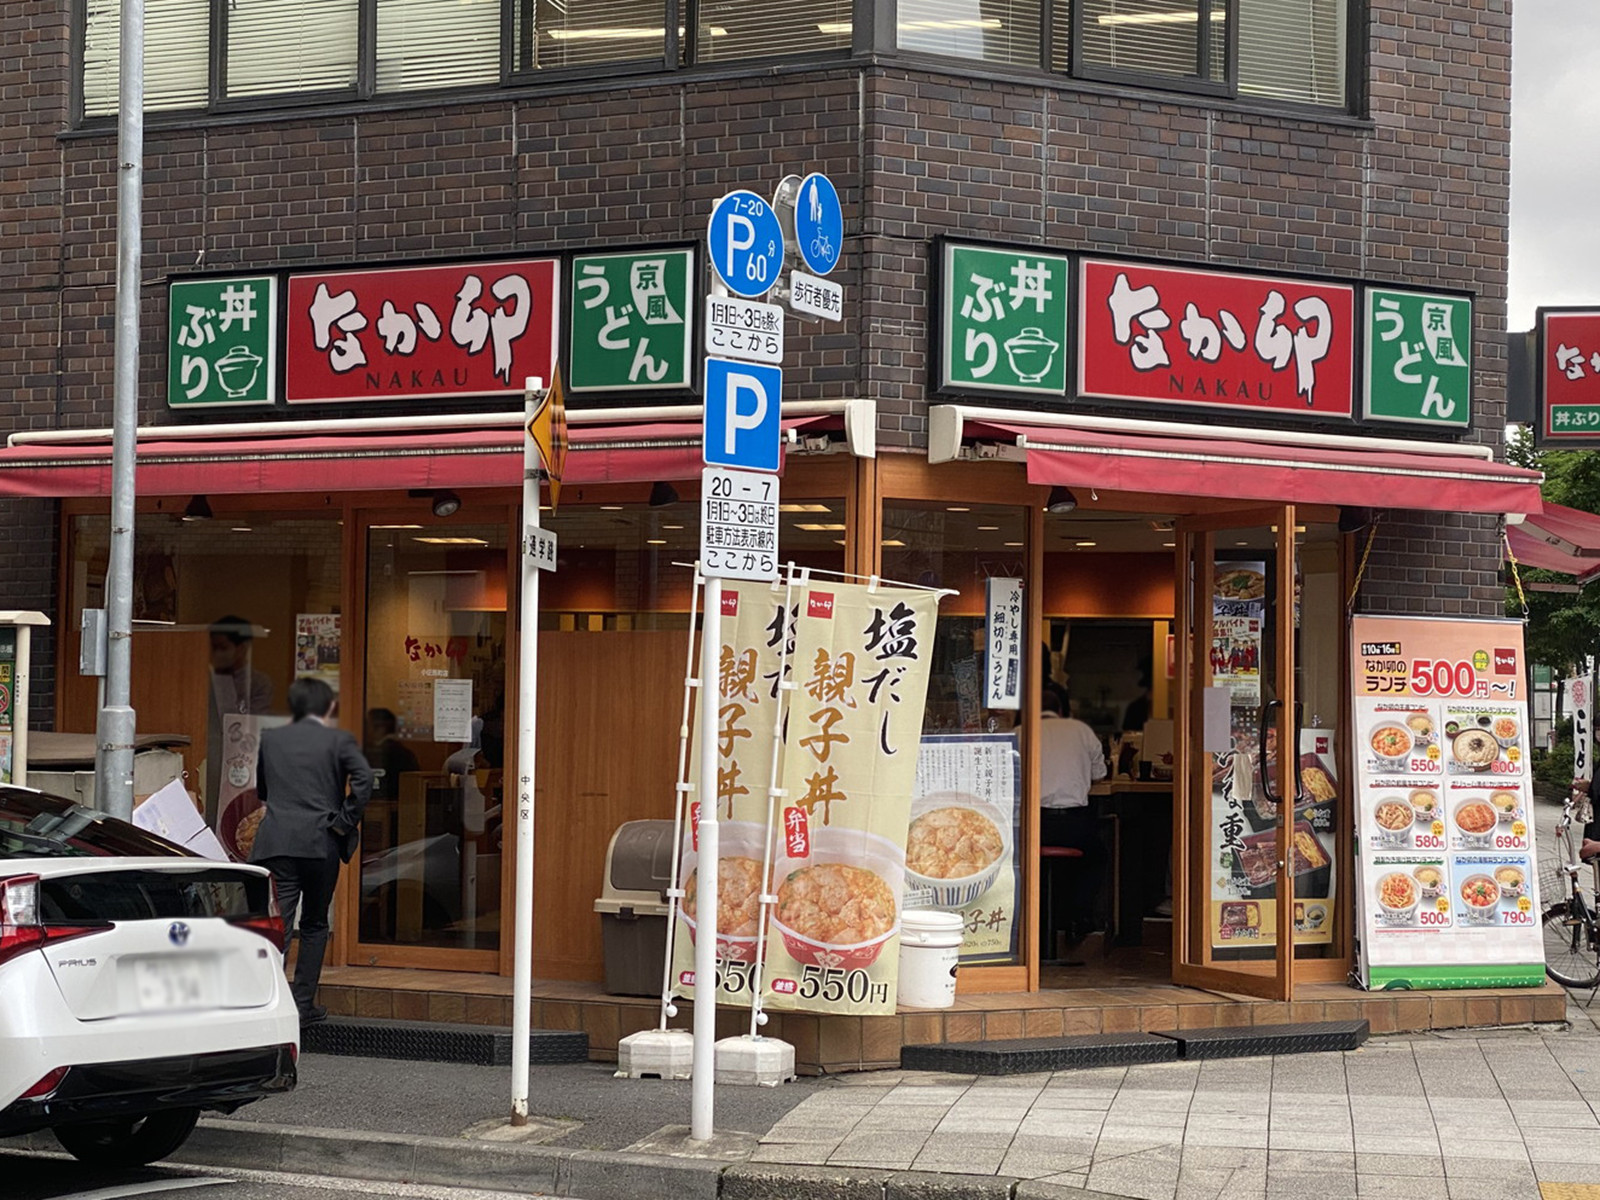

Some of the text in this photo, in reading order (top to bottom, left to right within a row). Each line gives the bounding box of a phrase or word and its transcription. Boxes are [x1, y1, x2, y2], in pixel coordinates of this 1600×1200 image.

[733, 197, 763, 217] 7-20
[727, 214, 755, 277] P
[636, 264, 668, 320] 京風
[794, 281, 840, 313] 歩行者優先
[309, 274, 531, 386] なか卯
[578, 265, 669, 382] うどん
[1427, 307, 1454, 361] 京風
[712, 329, 778, 354] ここから
[1108, 273, 1332, 405] なか卯
[1375, 298, 1455, 418] うどん
[366, 368, 468, 389] NAKAU
[1169, 374, 1272, 400] NAKAU
[725, 372, 768, 455] P
[712, 477, 732, 497] 20
[762, 482, 771, 501] 7
[707, 550, 773, 572] ここから
[862, 602, 918, 755] 塩だし
[1366, 660, 1407, 673] なか卯の
[1366, 676, 1407, 692] ランチ
[796, 648, 858, 826] 親子丼
[1411, 759, 1441, 772] 550円
[1491, 760, 1521, 773] 600円
[521, 775, 530, 819] 中央区
[786, 810, 806, 853] 弁当
[1415, 835, 1445, 848] 580円
[1496, 835, 1526, 848] 690円
[1420, 911, 1450, 925] 500円
[1502, 911, 1533, 923] 790円
[59, 958, 97, 967] PRIUS
[800, 966, 888, 1003] 550円
